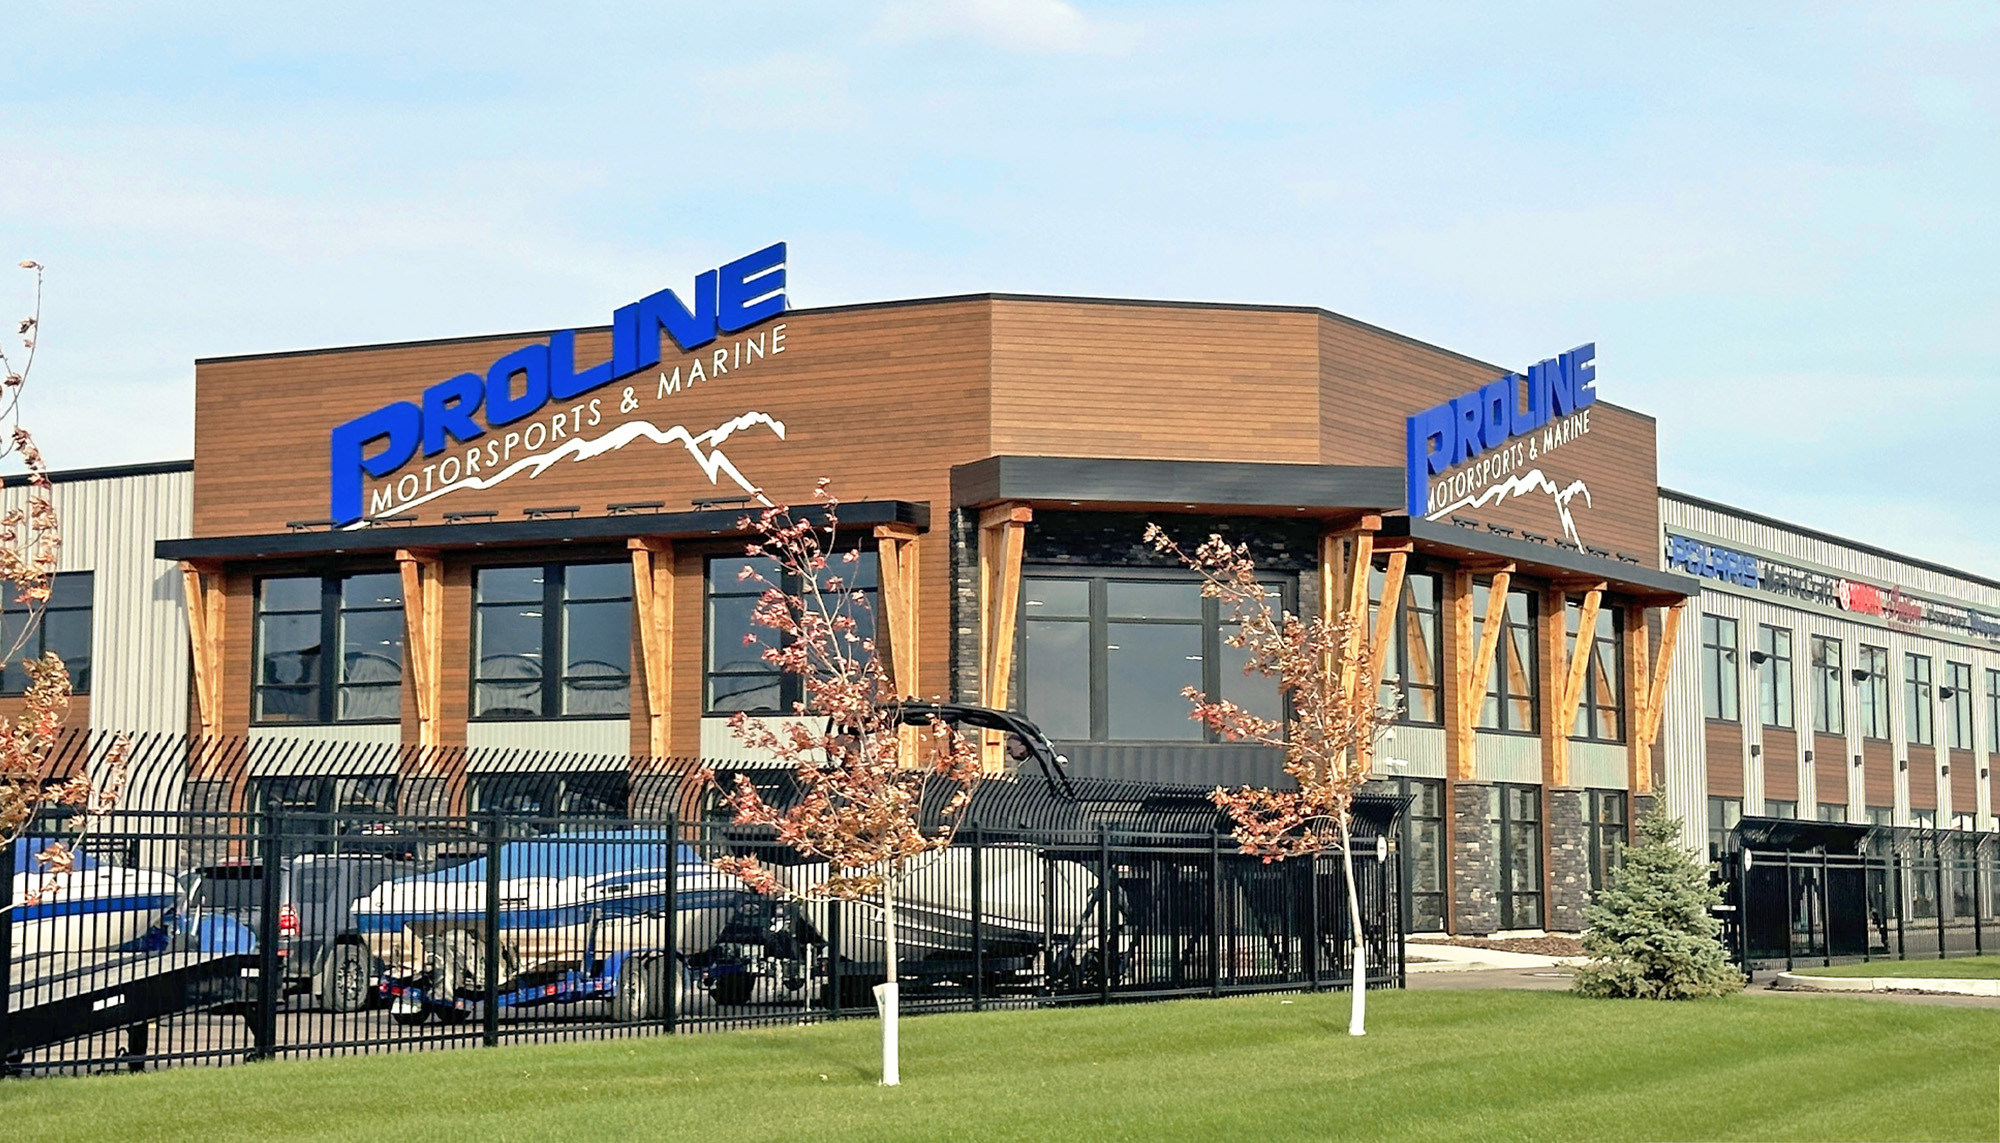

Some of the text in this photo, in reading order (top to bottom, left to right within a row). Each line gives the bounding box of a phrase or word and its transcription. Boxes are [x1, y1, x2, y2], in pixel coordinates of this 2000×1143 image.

[331, 241, 787, 528] PROLINE
[370, 324, 787, 515] MOTORSPORTS & MARINE
[1406, 342, 1596, 517] PROLINE
[1425, 410, 1590, 515] MOTORSPORTS & MARINE
[1673, 535, 1758, 589] POLARIS
